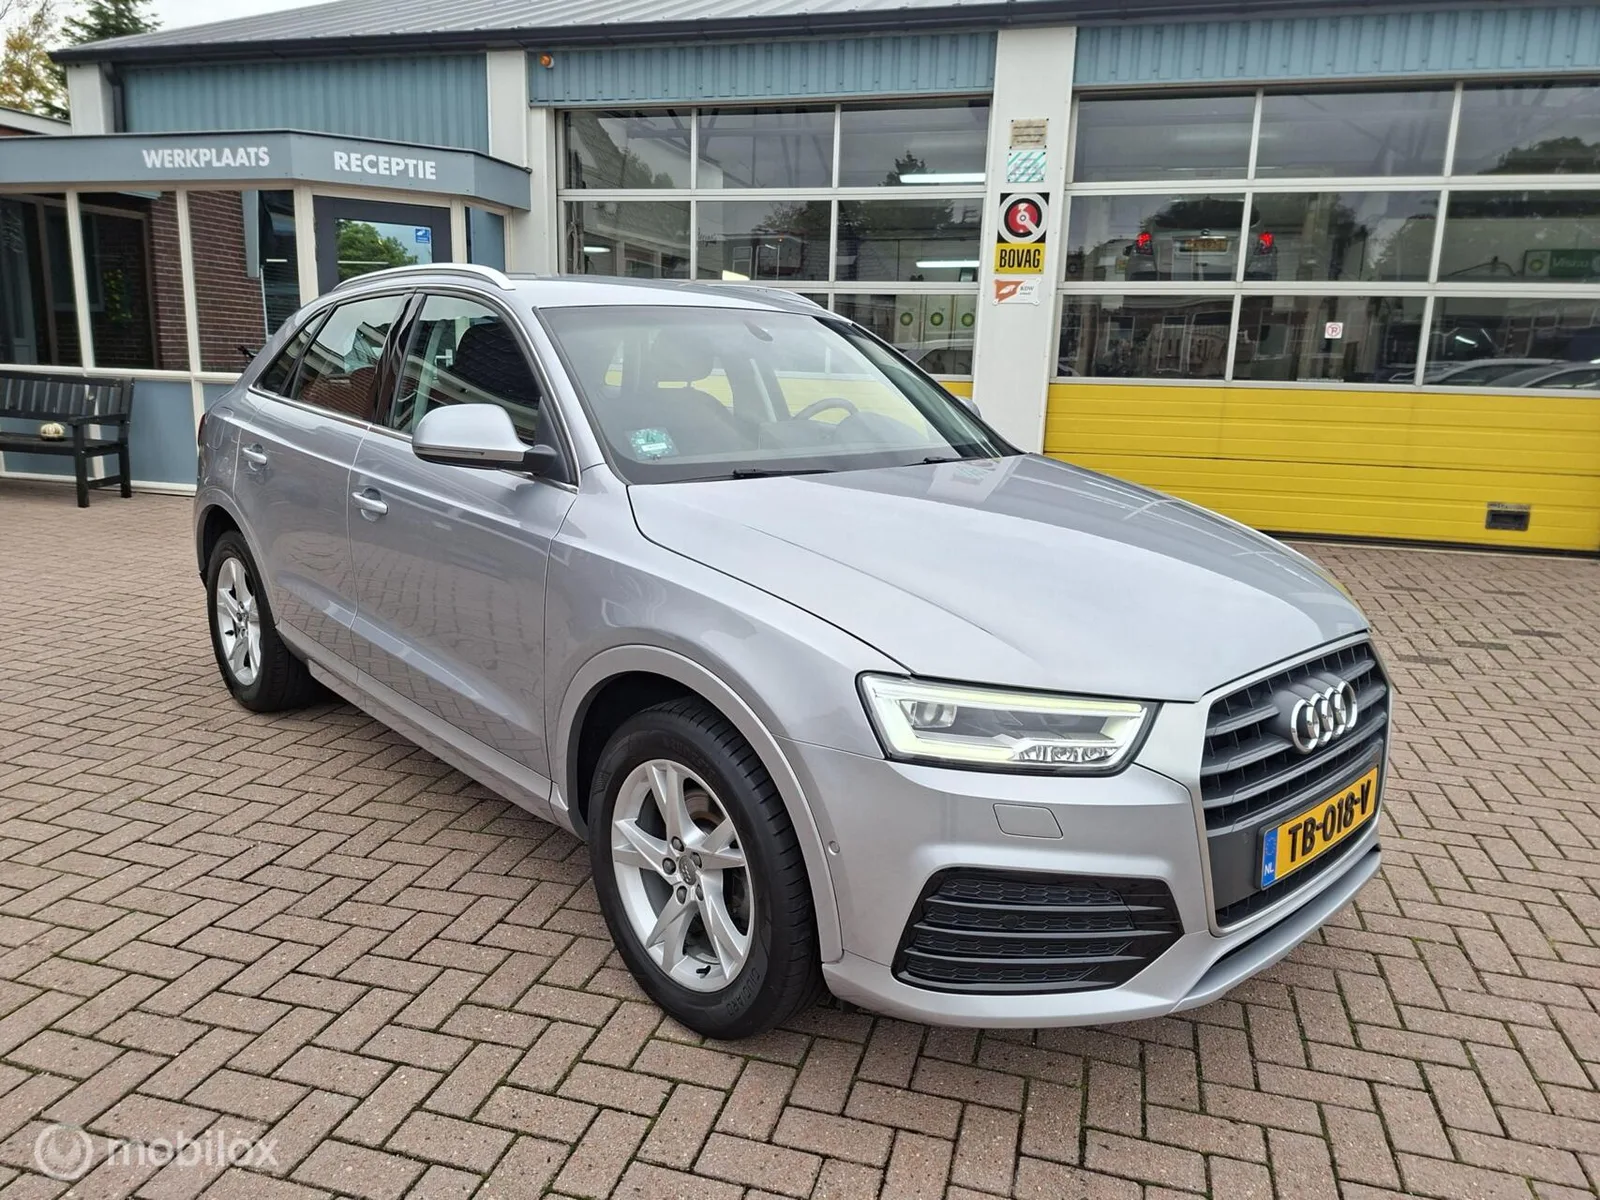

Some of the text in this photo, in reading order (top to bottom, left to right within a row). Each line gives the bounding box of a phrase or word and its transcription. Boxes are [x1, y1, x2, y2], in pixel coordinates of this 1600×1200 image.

[142, 145, 270, 169] WERKPLAATS
[333, 150, 437, 180] RECEPTIE
[999, 248, 1041, 269] BOVAG
[1287, 779, 1372, 863] TB-018-V
[1264, 862, 1275, 876] NL
